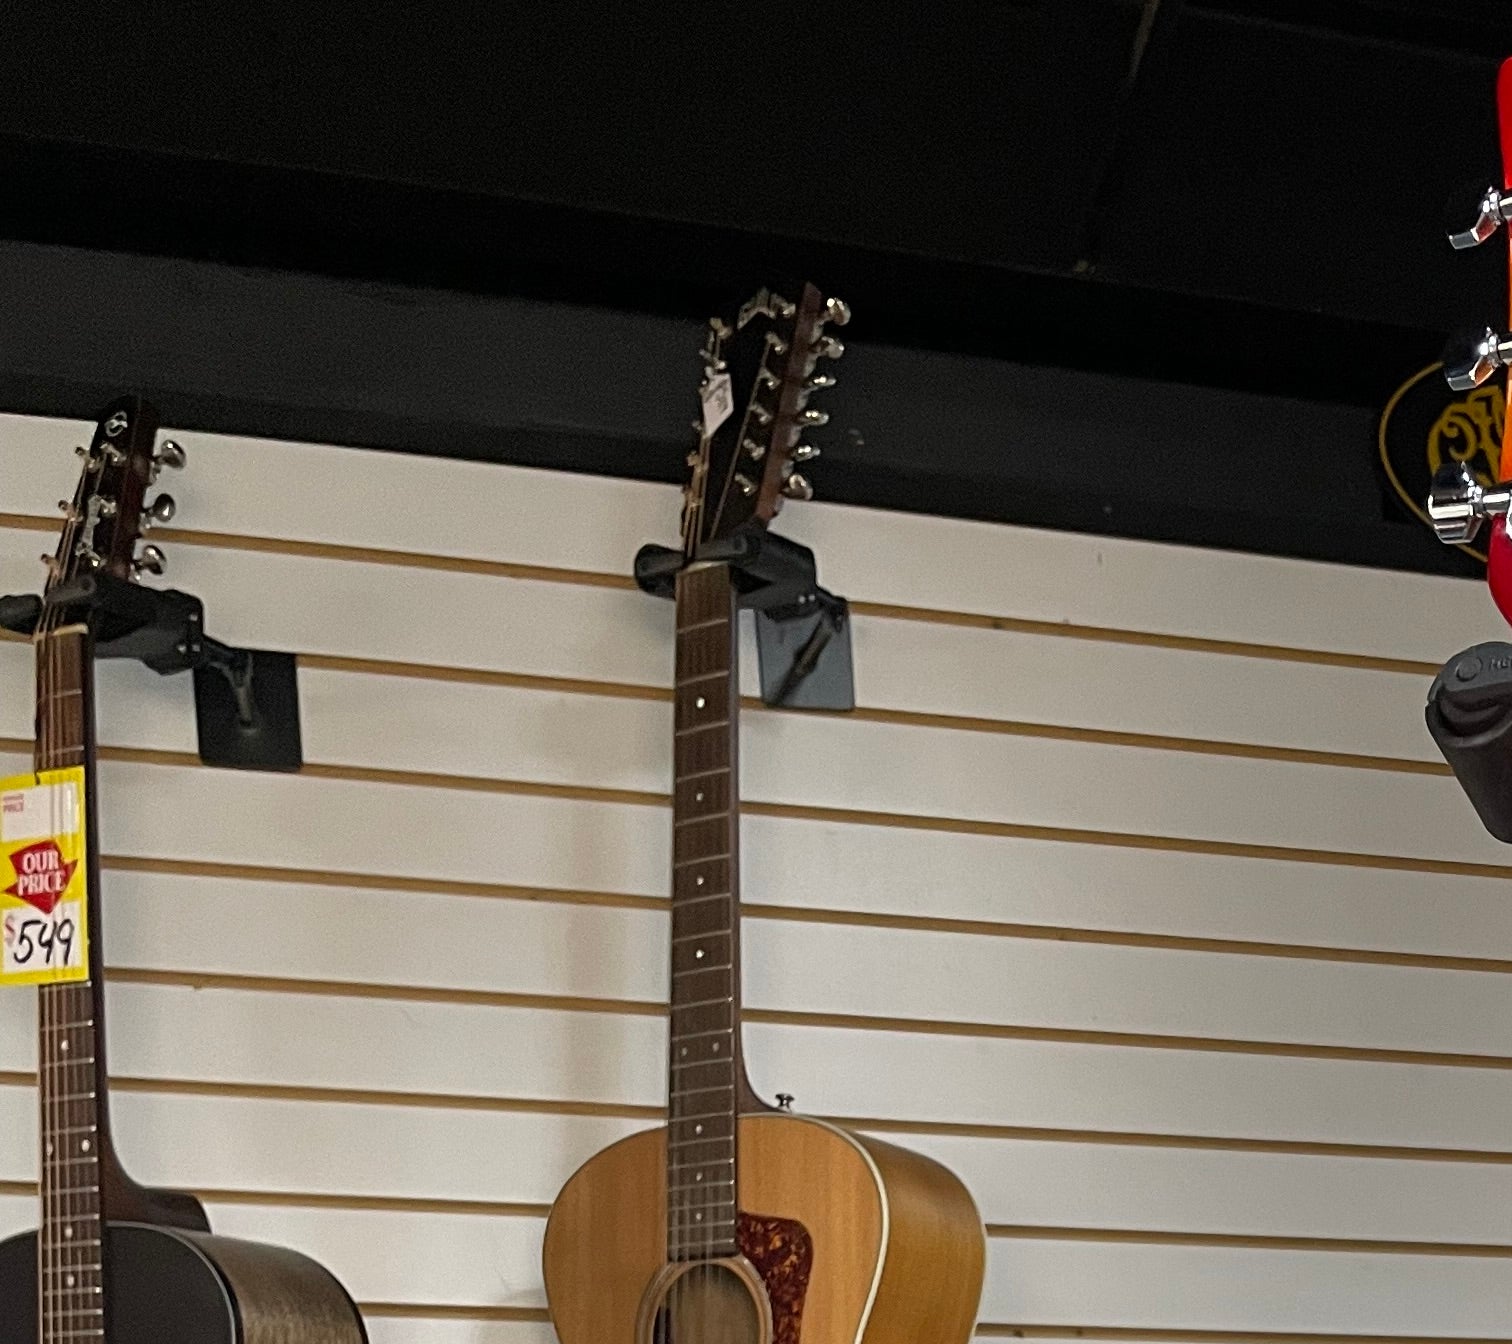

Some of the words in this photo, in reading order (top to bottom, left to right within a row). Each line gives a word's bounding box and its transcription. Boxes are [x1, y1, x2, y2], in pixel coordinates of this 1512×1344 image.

[22, 850, 60, 875] OUR
[18, 871, 66, 896] PRICE
[4, 915, 74, 966] $549
